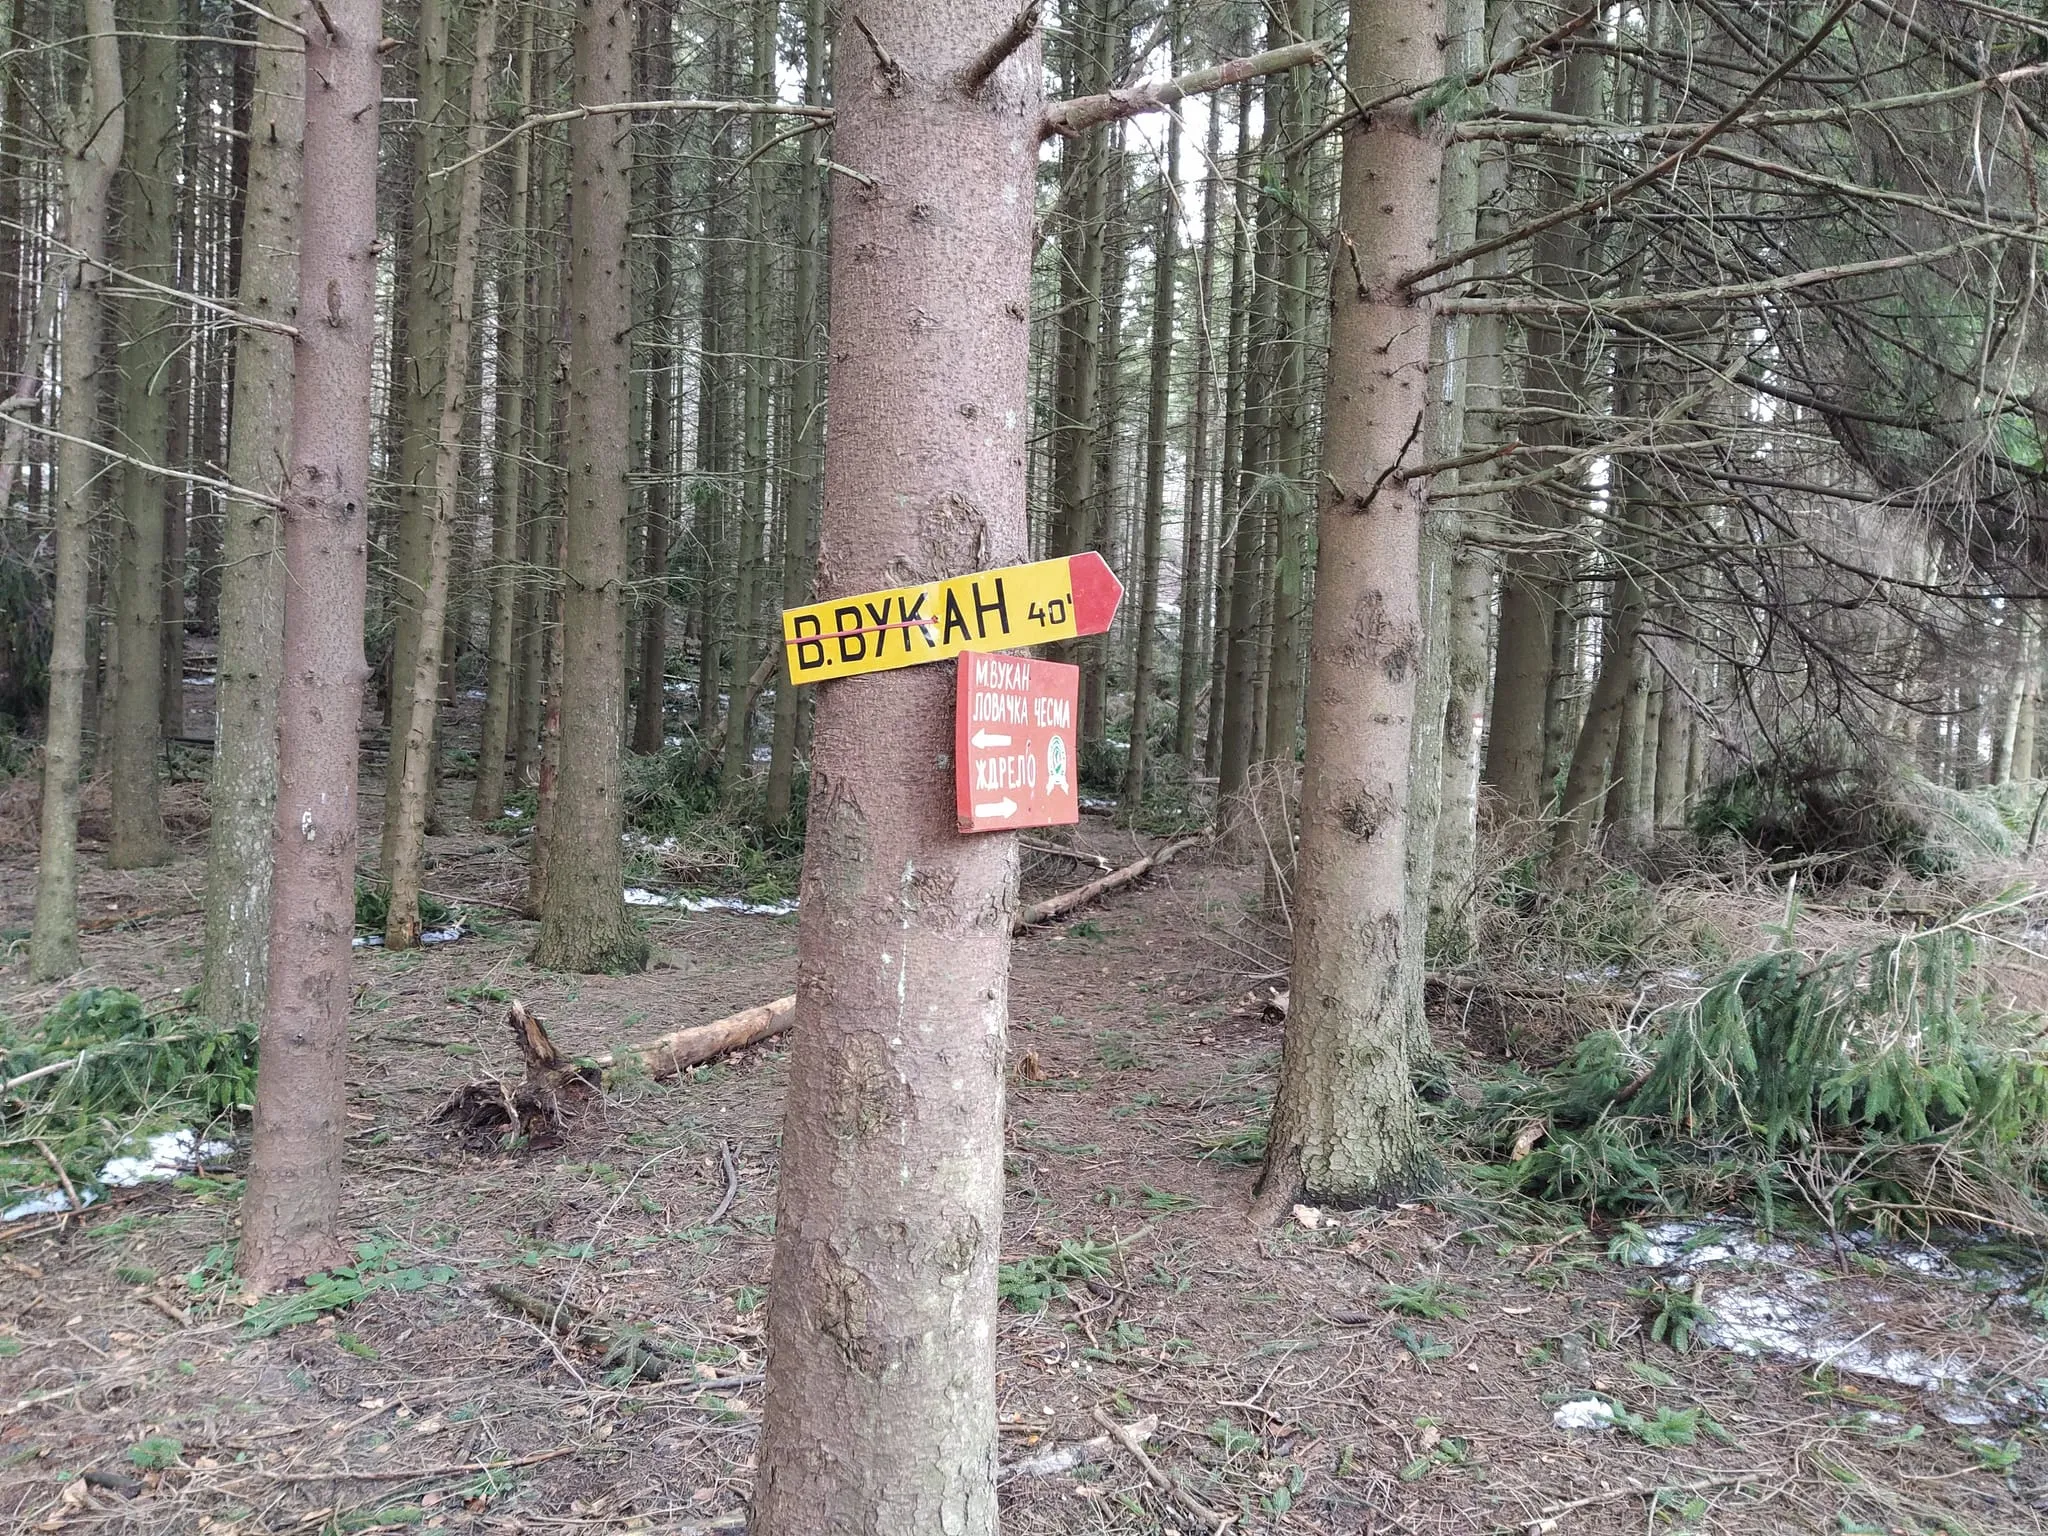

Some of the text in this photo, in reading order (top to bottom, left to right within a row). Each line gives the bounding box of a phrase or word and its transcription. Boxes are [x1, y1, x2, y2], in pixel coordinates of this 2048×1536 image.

[972, 692, 1071, 729] ЛОВАЧКА ЧЕСМА
[975, 754, 1036, 792] ЖДРЕЛО
